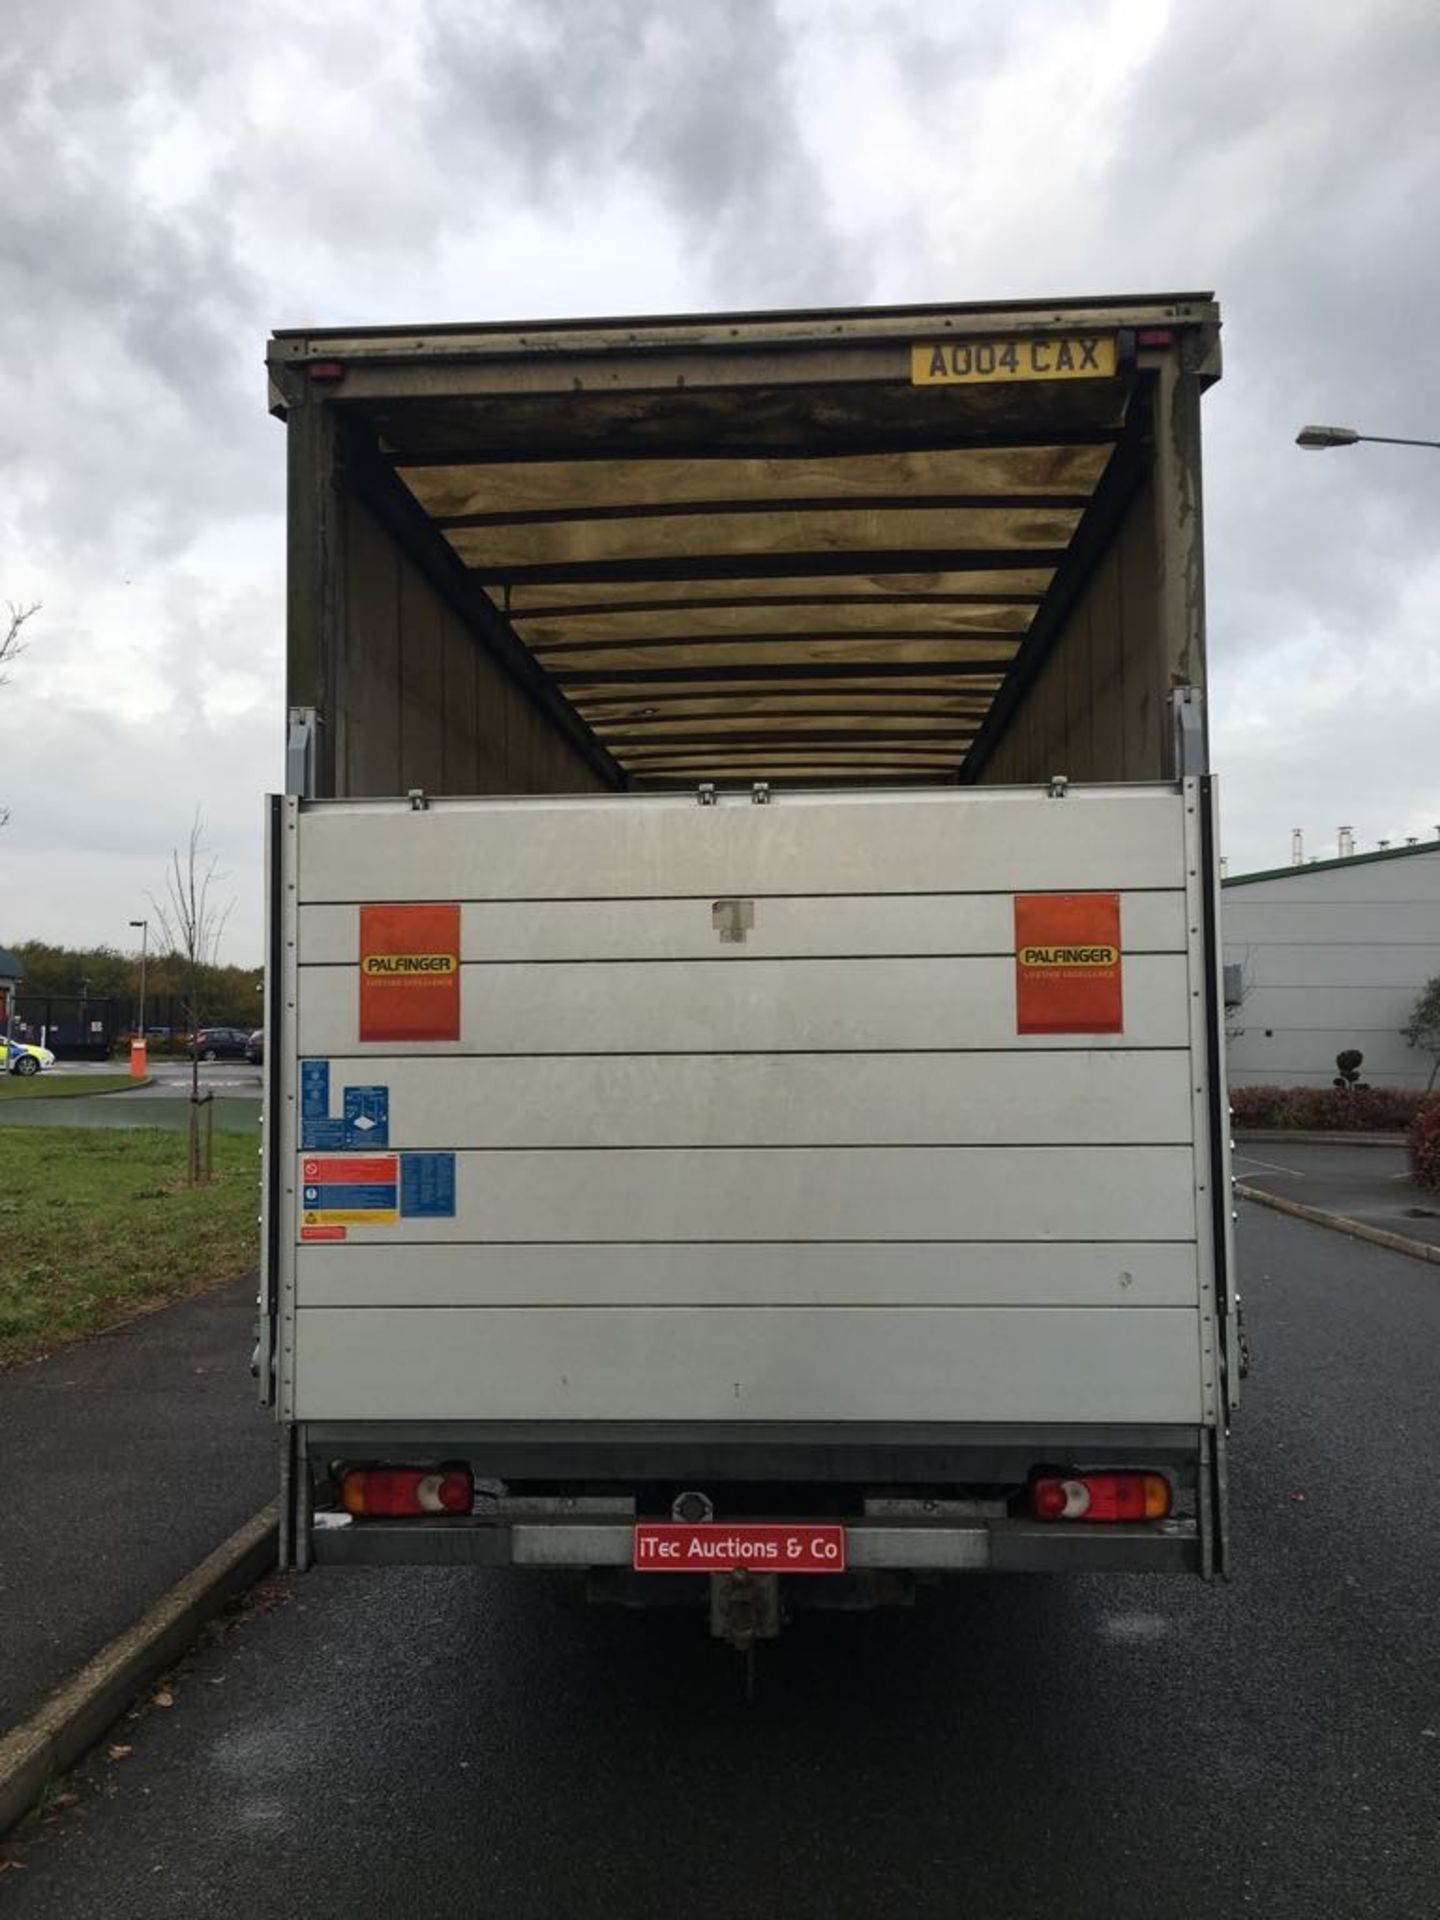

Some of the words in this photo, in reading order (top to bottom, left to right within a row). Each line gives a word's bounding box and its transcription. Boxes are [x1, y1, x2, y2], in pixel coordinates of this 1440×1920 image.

[1030, 338, 1099, 373] CAX
[367, 957, 451, 972] PALFINGER
[1025, 948, 1112, 963] PALFINGER
[640, 1537, 681, 1558] iTec
[687, 1537, 778, 1558] Auctions
[786, 1537, 803, 1558] &
[810, 1538, 838, 1558] Co
